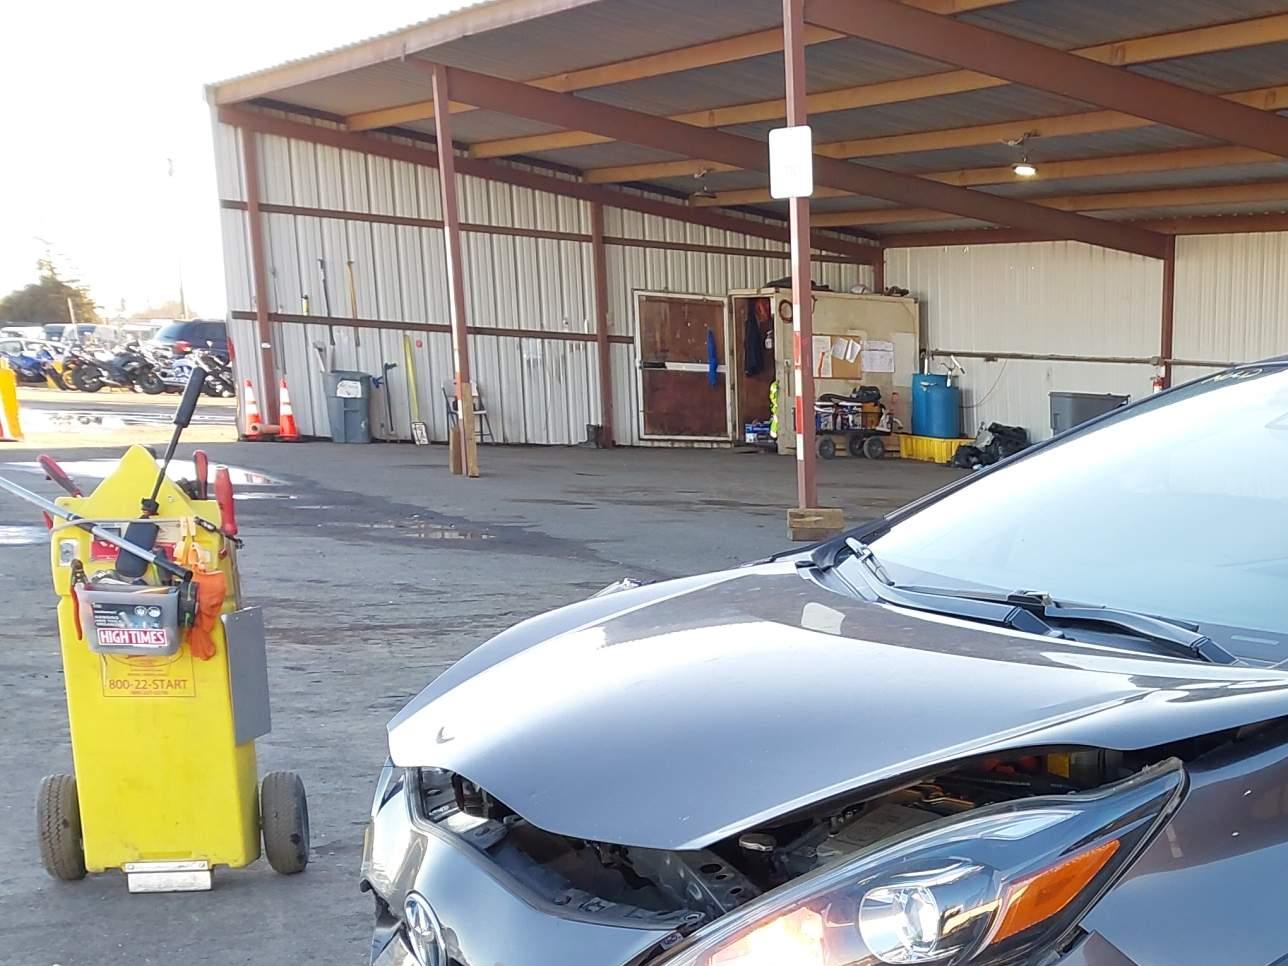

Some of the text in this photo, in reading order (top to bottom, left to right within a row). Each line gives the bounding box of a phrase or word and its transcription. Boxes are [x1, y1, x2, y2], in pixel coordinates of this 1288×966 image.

[100, 629, 165, 645] HIGH TIMES
[108, 679, 189, 690] 800-22-START
